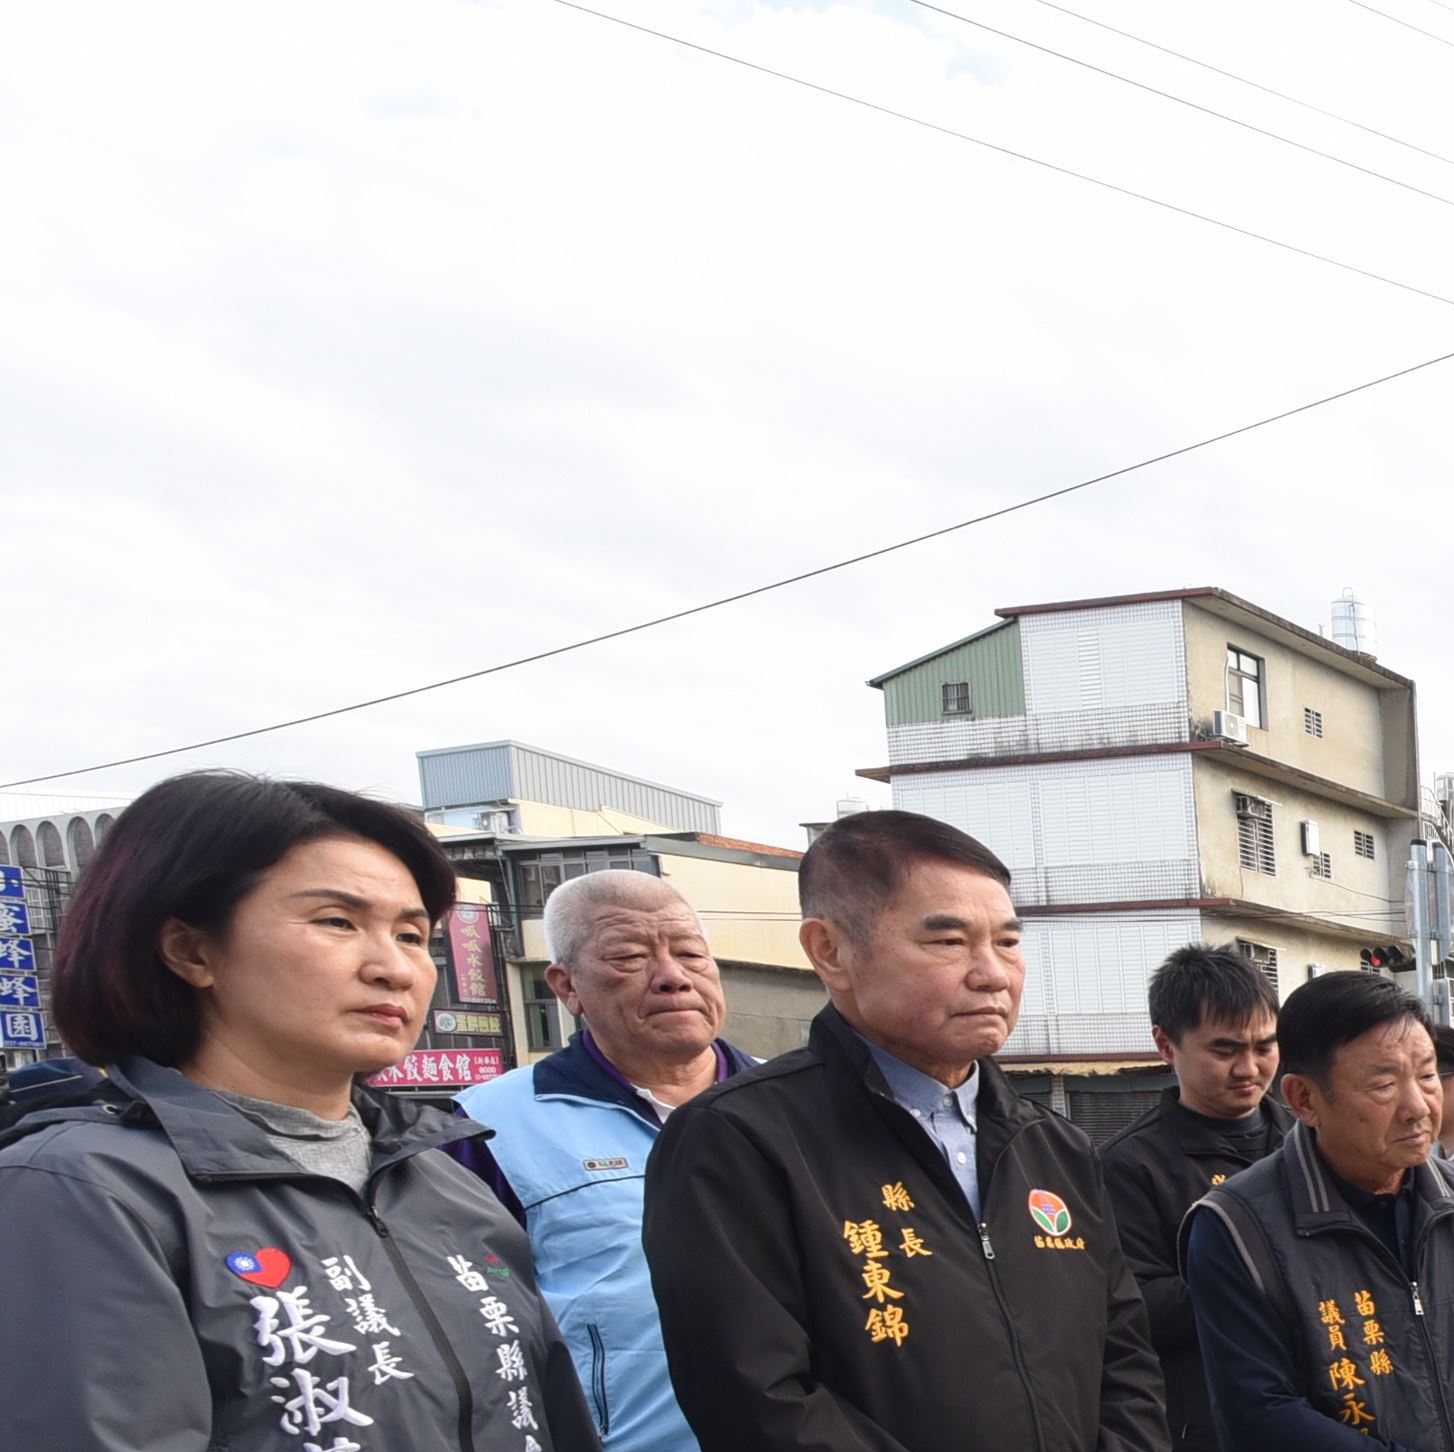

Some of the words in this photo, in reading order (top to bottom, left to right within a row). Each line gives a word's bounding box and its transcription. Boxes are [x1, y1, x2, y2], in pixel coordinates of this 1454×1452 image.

[881, 1181, 933, 1258] 縣長
[321, 1255, 415, 1385] 副議長
[843, 1219, 910, 1347] 鍾東錦
[1318, 1299, 1348, 1351] 議員
[1354, 1290, 1394, 1376] 苗栗縣
[1328, 1357, 1377, 1436] 陳永
